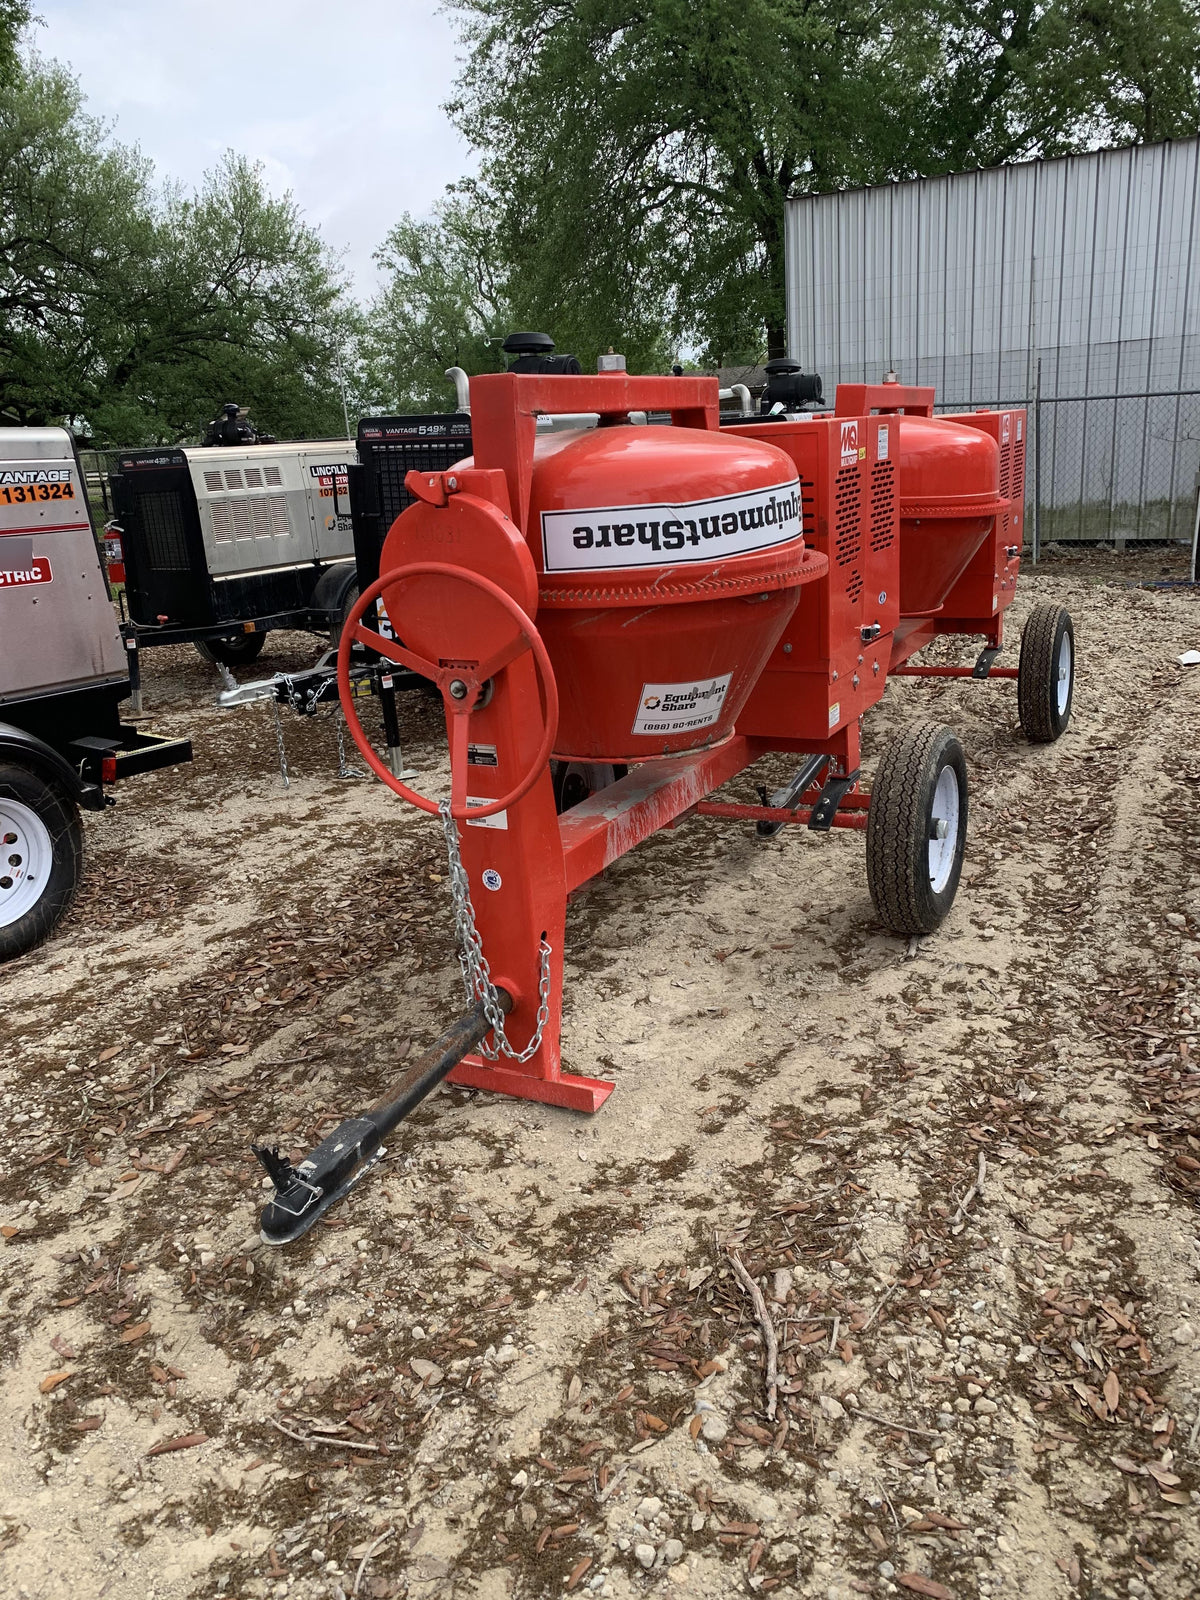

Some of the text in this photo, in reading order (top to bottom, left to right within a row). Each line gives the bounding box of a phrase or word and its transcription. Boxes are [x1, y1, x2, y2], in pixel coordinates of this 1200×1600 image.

[311, 465, 348, 477] LINCOLN
[2, 483, 74, 503] 131324
[320, 486, 348, 497] 10752
[661, 702, 697, 712] Share
[643, 715, 713, 731] (888) 80-RENTS
